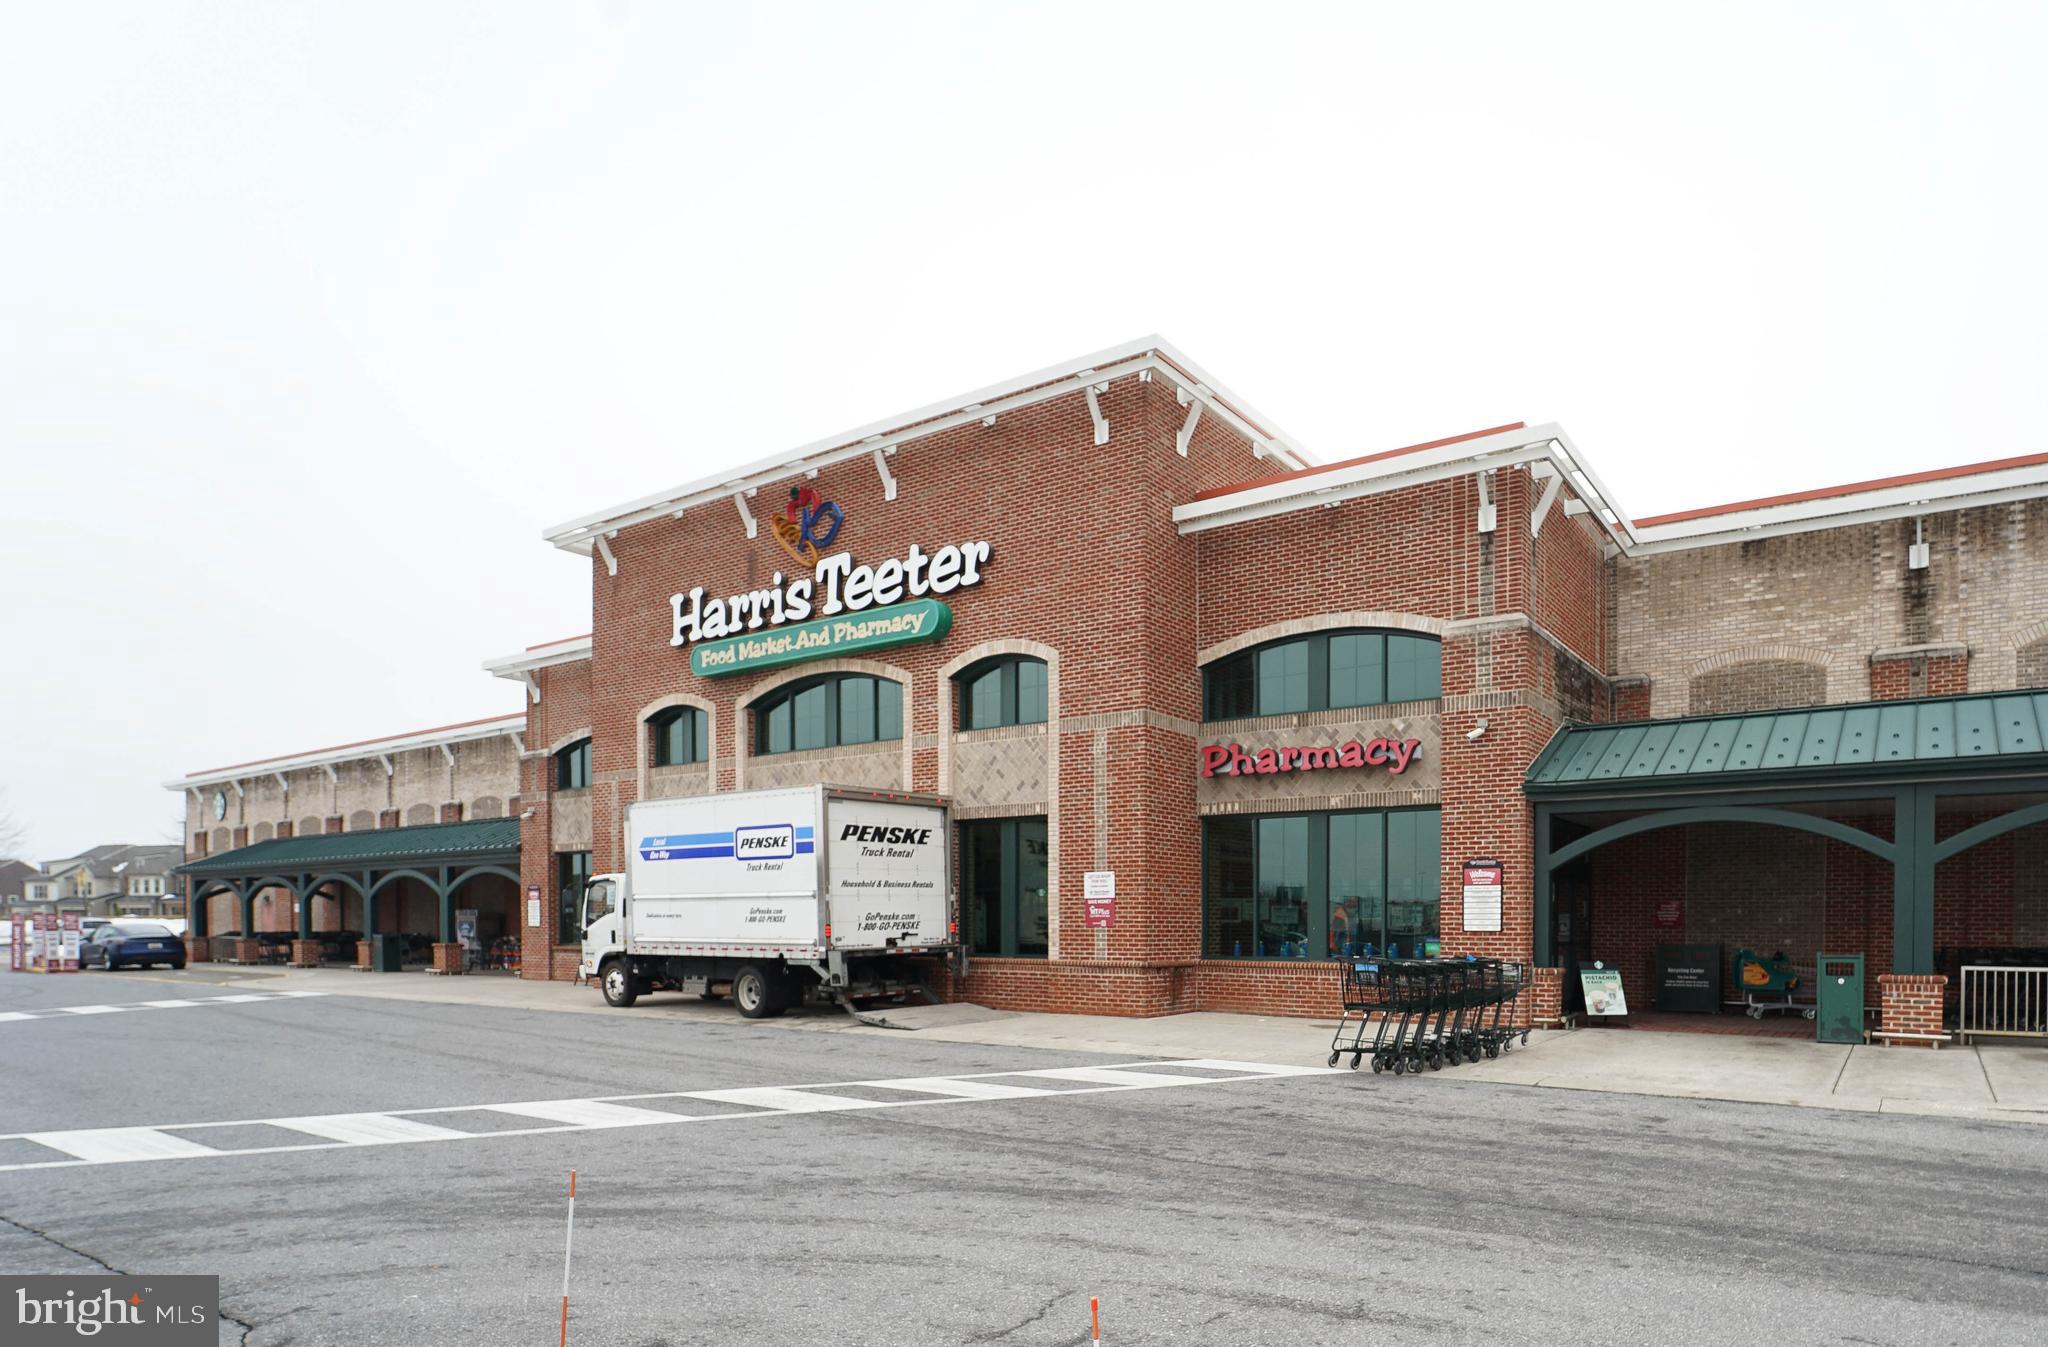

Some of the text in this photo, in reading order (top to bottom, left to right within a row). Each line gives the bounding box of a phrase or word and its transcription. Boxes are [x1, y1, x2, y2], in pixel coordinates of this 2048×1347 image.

[669, 541, 990, 647] Harris Teeter
[701, 609, 929, 668] Food Market And Pharmacy
[1201, 738, 1421, 779] Pharmacy
[840, 824, 932, 845] PENSKE
[740, 835, 790, 849] PENSKE
[861, 846, 915, 858] Truck Rental
[746, 860, 784, 871] Truck Rental
[840, 880, 934, 889] Household & Business Rentals
[865, 912, 916, 921] GoPenske.com
[857, 921, 920, 931] 1-800-GO-PENSKE
